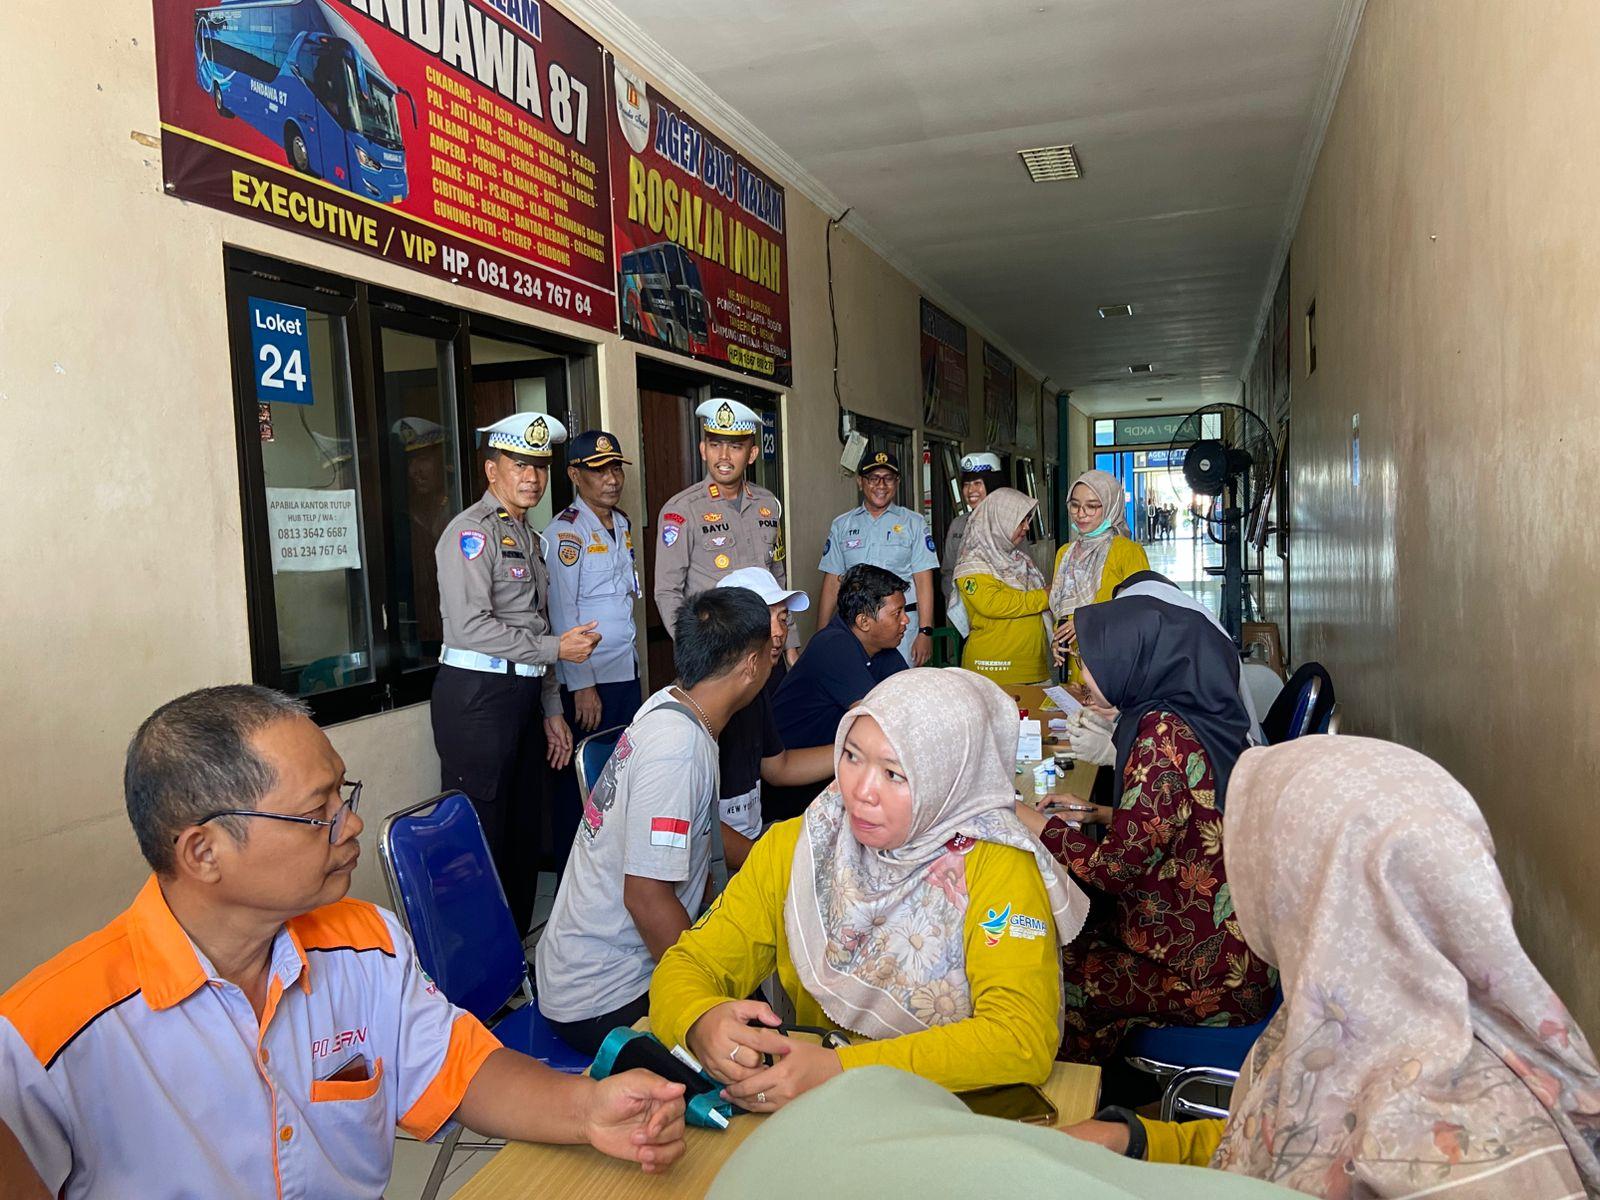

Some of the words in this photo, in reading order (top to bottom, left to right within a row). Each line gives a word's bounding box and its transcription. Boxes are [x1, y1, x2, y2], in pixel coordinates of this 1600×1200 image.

[425, 65, 472, 104] CIKARANG
[477, 95, 494, 118] JATI
[494, 103, 514, 128] ASIH
[426, 87, 444, 111] PAL
[450, 101, 468, 123] JATI
[469, 109, 493, 136] JAJAR
[498, 126, 535, 159] CIBINONG
[548, 63, 589, 146] 87
[429, 132, 467, 165] AMPERA
[472, 152, 498, 179] PORIS
[543, 188, 569, 213] BITUNG
[474, 133, 506, 164] YASMIN
[510, 152, 557, 189] CENGKARENG
[654, 103, 702, 182] AGEN
[703, 137, 735, 203] BUS
[736, 161, 783, 235] MALAM
[231, 169, 379, 248] EXECUTIVE
[400, 229, 437, 265] VIP
[432, 177, 475, 210] CIBITUNG
[480, 197, 511, 224] BEKASI
[514, 212, 544, 239] BANTAR
[543, 223, 571, 250] GEBANG
[433, 198, 472, 231] GUNUNG
[471, 214, 498, 239] PUTRI
[536, 240, 571, 268] CILODONG
[466, 171, 483, 193] JATI
[529, 200, 551, 223] KLARI
[554, 211, 586, 239] KRAWANG
[628, 154, 726, 267] ROSALIA
[729, 216, 781, 295] INDAH
[441, 244, 473, 279] HP.
[477, 257, 510, 291] 081
[513, 270, 543, 301] 234
[545, 281, 572, 310] 767
[574, 291, 593, 317] 64
[255, 308, 302, 336] Loket
[259, 343, 307, 392] 24
[763, 433, 775, 454] 23
[270, 500, 299, 510] APABILA
[301, 500, 329, 510] KANTOR
[330, 500, 352, 510] TUTUP
[277, 528, 301, 540] 0813
[303, 527, 325, 539] 3642
[326, 526, 348, 538] 6687
[287, 514, 302, 522] HUB
[303, 514, 317, 522] TELP
[701, 522, 730, 534] BAYU
[848, 529, 860, 537] TRI
[281, 546, 298, 559] 081
[300, 545, 317, 557] 234
[319, 544, 335, 557] 767
[337, 544, 348, 555] 64
